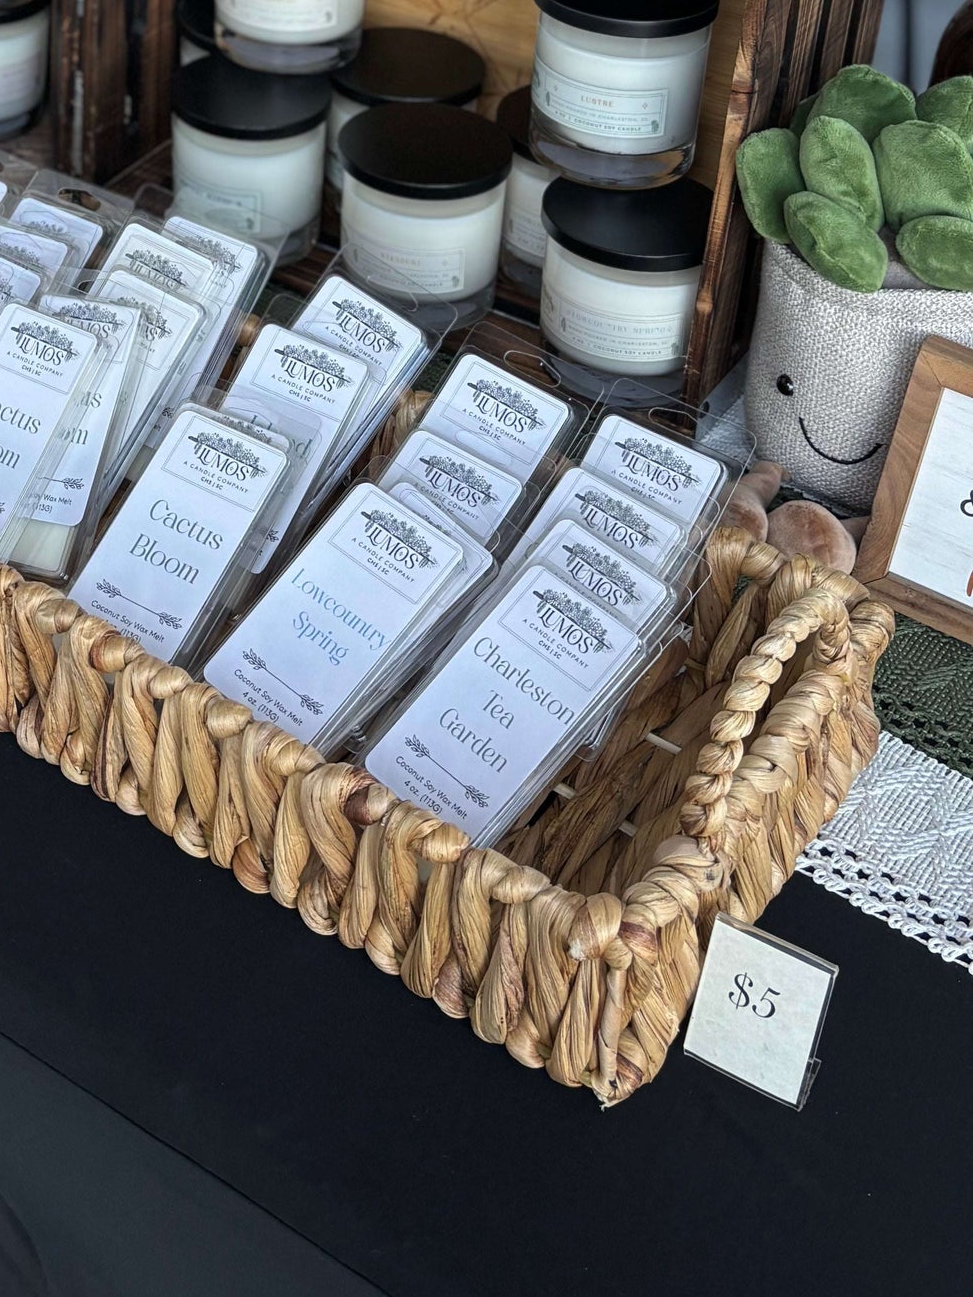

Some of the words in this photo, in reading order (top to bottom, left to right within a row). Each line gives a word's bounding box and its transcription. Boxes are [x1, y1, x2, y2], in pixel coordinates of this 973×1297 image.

[19, 334, 65, 366] LUMOS
[341, 315, 387, 354] LUMOS
[13, 353, 35, 368] CANDLE
[36, 363, 63, 377] COMPANY
[22, 364, 32, 373] CHS
[284, 356, 336, 392] LUMOS
[278, 376, 303, 391] CANDLE
[305, 388, 335, 404] COMPANY
[289, 389, 300, 398] CHS
[476, 397, 527, 433] LUMOS
[190, 463, 215, 479] CANDLE
[217, 474, 248, 493] COMPANY
[197, 448, 250, 483] LUMOS
[200, 476, 211, 485] CHS
[626, 454, 681, 492] LUMOS
[429, 471, 481, 508] LUMOS
[149, 499, 224, 550] Cactus
[584, 508, 639, 549] LUMOS
[129, 533, 200, 584] Bloom
[358, 540, 384, 563] CANDLE
[384, 559, 414, 583] COMPANY
[367, 522, 421, 570] LUMOS
[367, 557, 378, 569] CHS
[570, 560, 623, 606] LUMOS
[291, 568, 393, 651] Lowcountry
[293, 611, 349, 666] Spring
[529, 622, 557, 646] CANDLE
[556, 643, 589, 669] COMPANY
[539, 607, 593, 654] LUMOS
[539, 641, 552, 653] CHS
[234, 669, 263, 695] Coconut
[261, 689, 275, 706] Soy
[273, 700, 289, 715] Wax
[288, 711, 303, 726] Melt
[243, 691, 248, 699] 4
[473, 636, 574, 727] Charleston
[481, 690, 514, 730] Tea
[439, 708, 507, 773] Garden
[396, 755, 425, 782] Coconut
[423, 777, 438, 795] Soy
[436, 788, 453, 803] Wax
[451, 800, 467, 820] Melt
[728, 970, 779, 1021] $5
